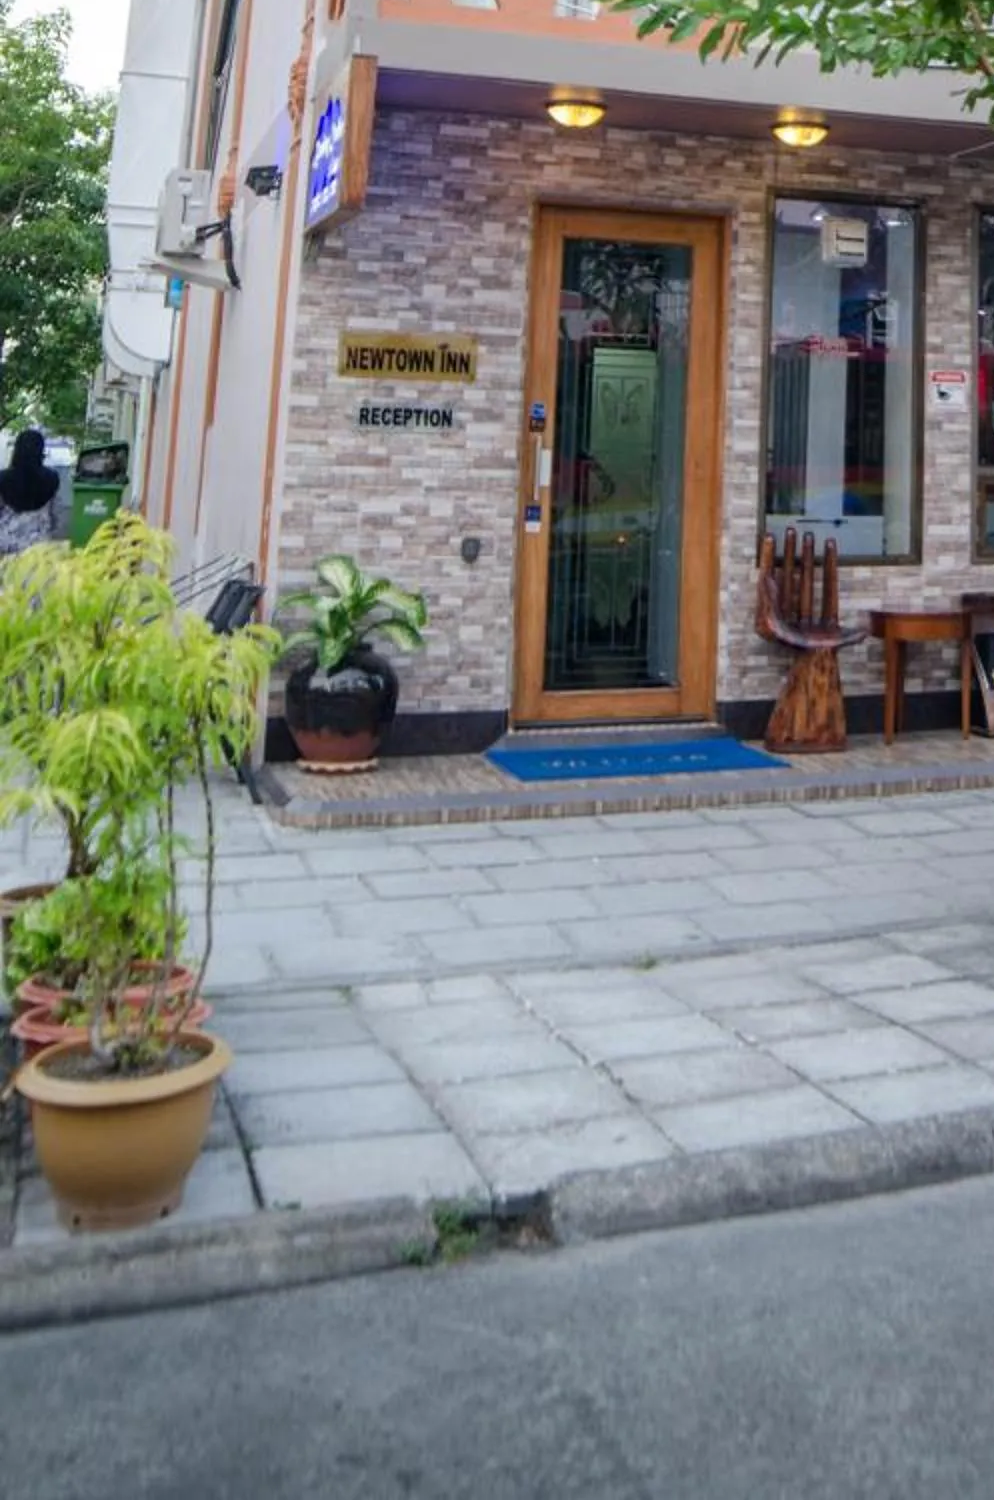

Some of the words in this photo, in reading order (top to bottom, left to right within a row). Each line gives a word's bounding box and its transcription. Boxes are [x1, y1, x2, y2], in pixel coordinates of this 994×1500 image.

[345, 345, 435, 373] NEWTOWN
[438, 343, 471, 375] INN
[358, 406, 453, 428] RECEPTION
